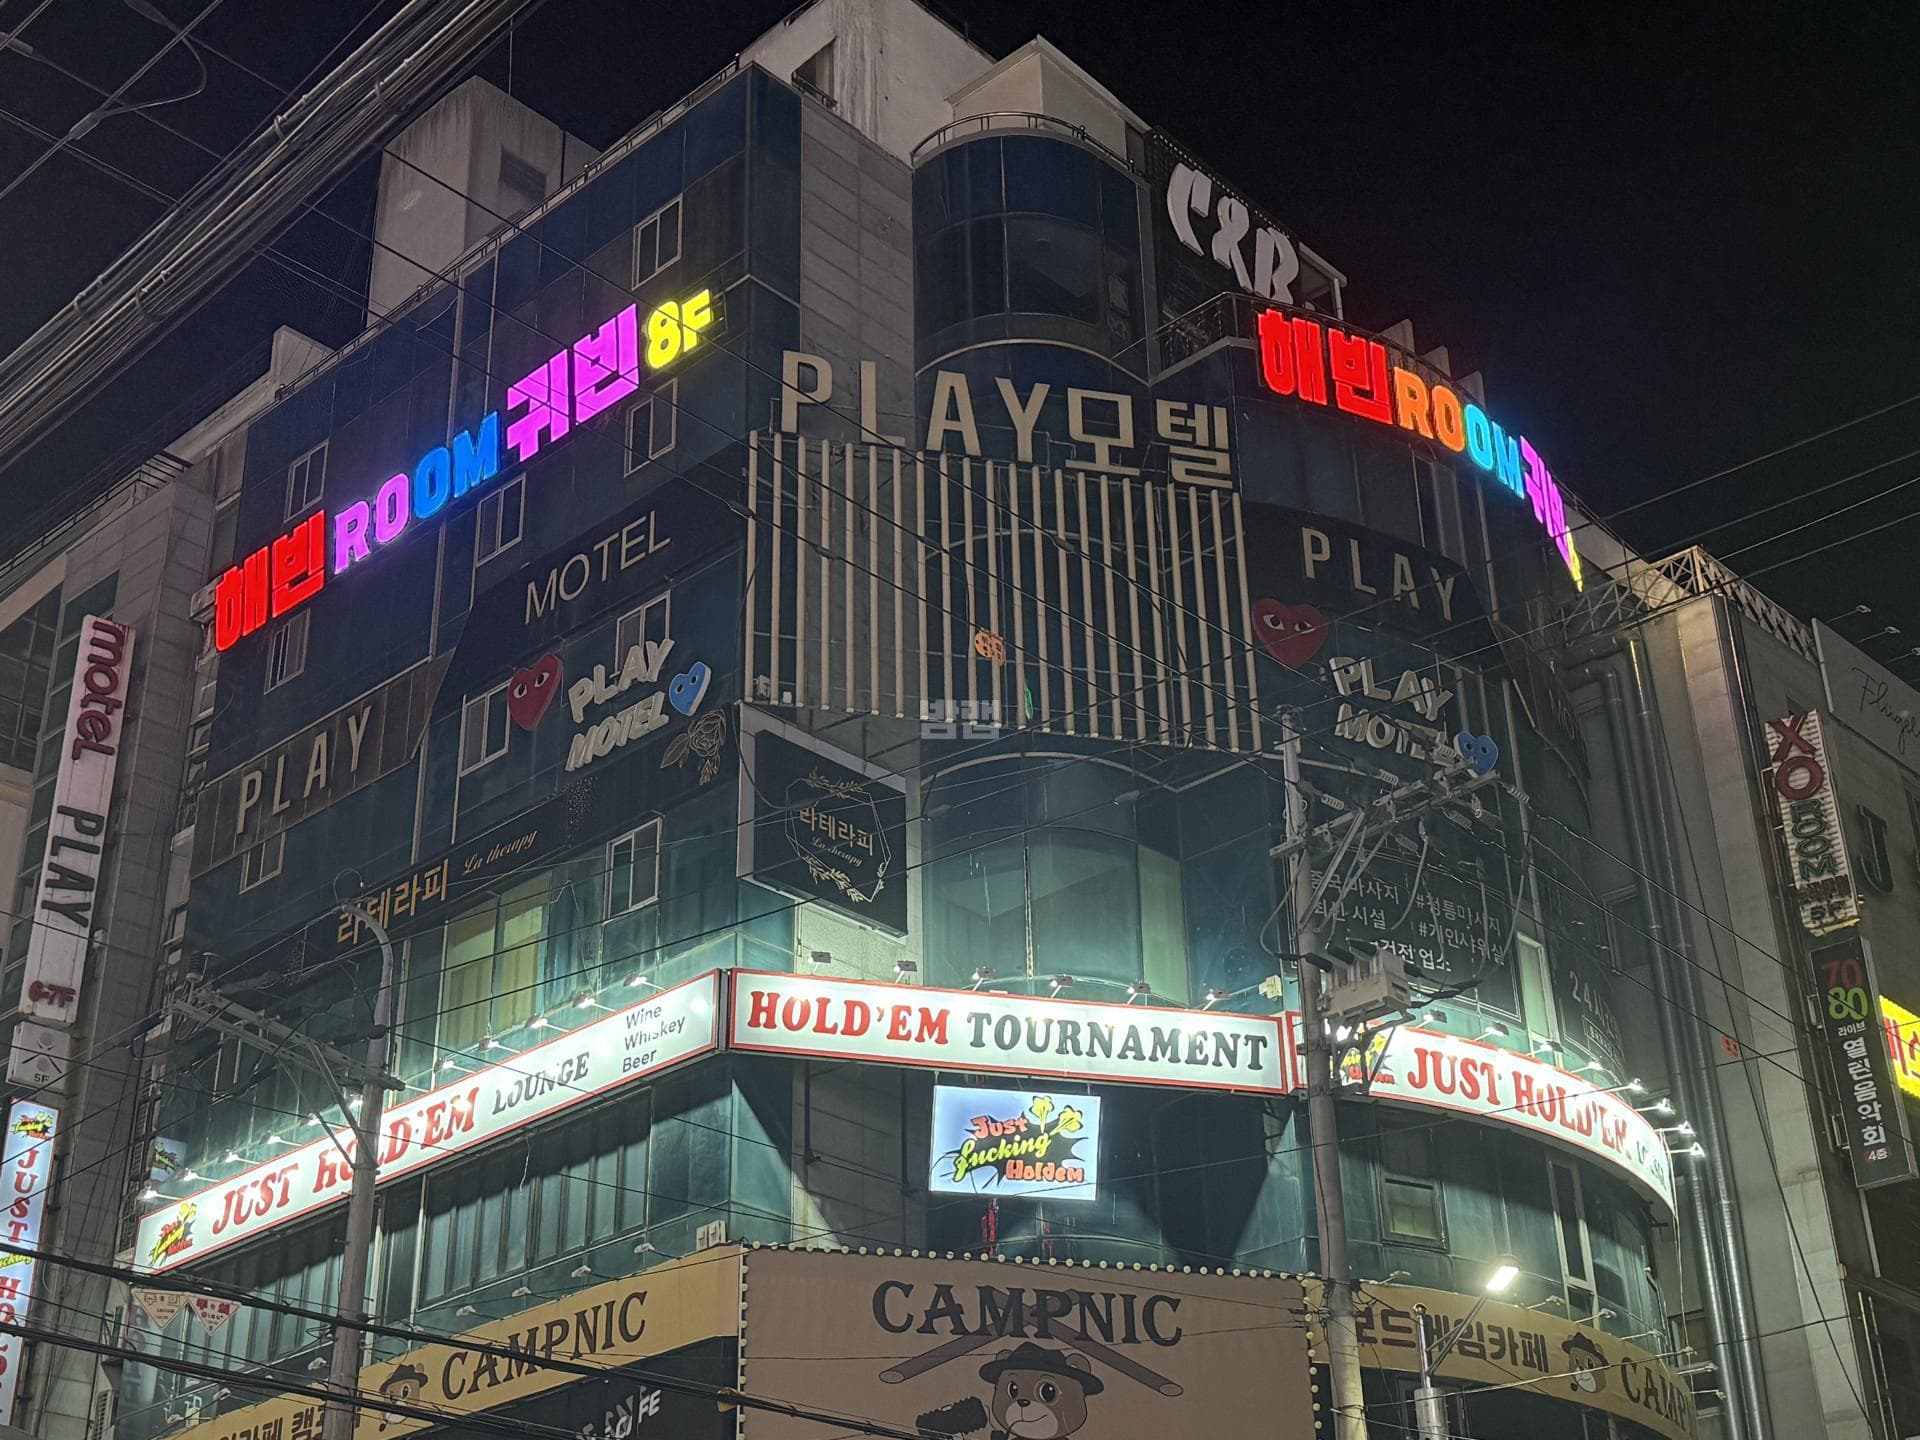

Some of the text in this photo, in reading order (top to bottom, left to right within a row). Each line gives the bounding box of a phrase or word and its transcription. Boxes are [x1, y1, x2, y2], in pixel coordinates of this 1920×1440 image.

[645, 289, 713, 369] 8F
[525, 510, 670, 624] MOTEL
[1302, 527, 1454, 622] PLAY
[72, 620, 126, 760] motel
[568, 638, 675, 724] PLAY
[1329, 656, 1454, 721] PLAY
[564, 692, 669, 772] MOTEL
[237, 706, 371, 834] PLAY
[41, 805, 104, 927] PLAY
[800, 807, 873, 856] 라테라피
[337, 858, 449, 944] 라테라피
[1352, 905, 1387, 931] 시설
[1824, 959, 1863, 987] 70
[1827, 986, 1869, 1020] 80
[624, 1017, 686, 1050] Whiskey
[625, 1005, 662, 1030] Wine
[748, 990, 949, 1044] HOLD'EM
[967, 1011, 1268, 1071] TOURNAMENT
[622, 1050, 657, 1073] Beer
[1407, 1048, 1501, 1105] JUST
[953, 1132, 1051, 1182] fucking
[970, 1115, 1029, 1139] Just
[8, 1149, 40, 1244] JUST
[212, 1163, 299, 1235] JUST
[441, 1290, 648, 1401] CAMPNIC
[872, 1281, 1183, 1347] CAMPNIC
